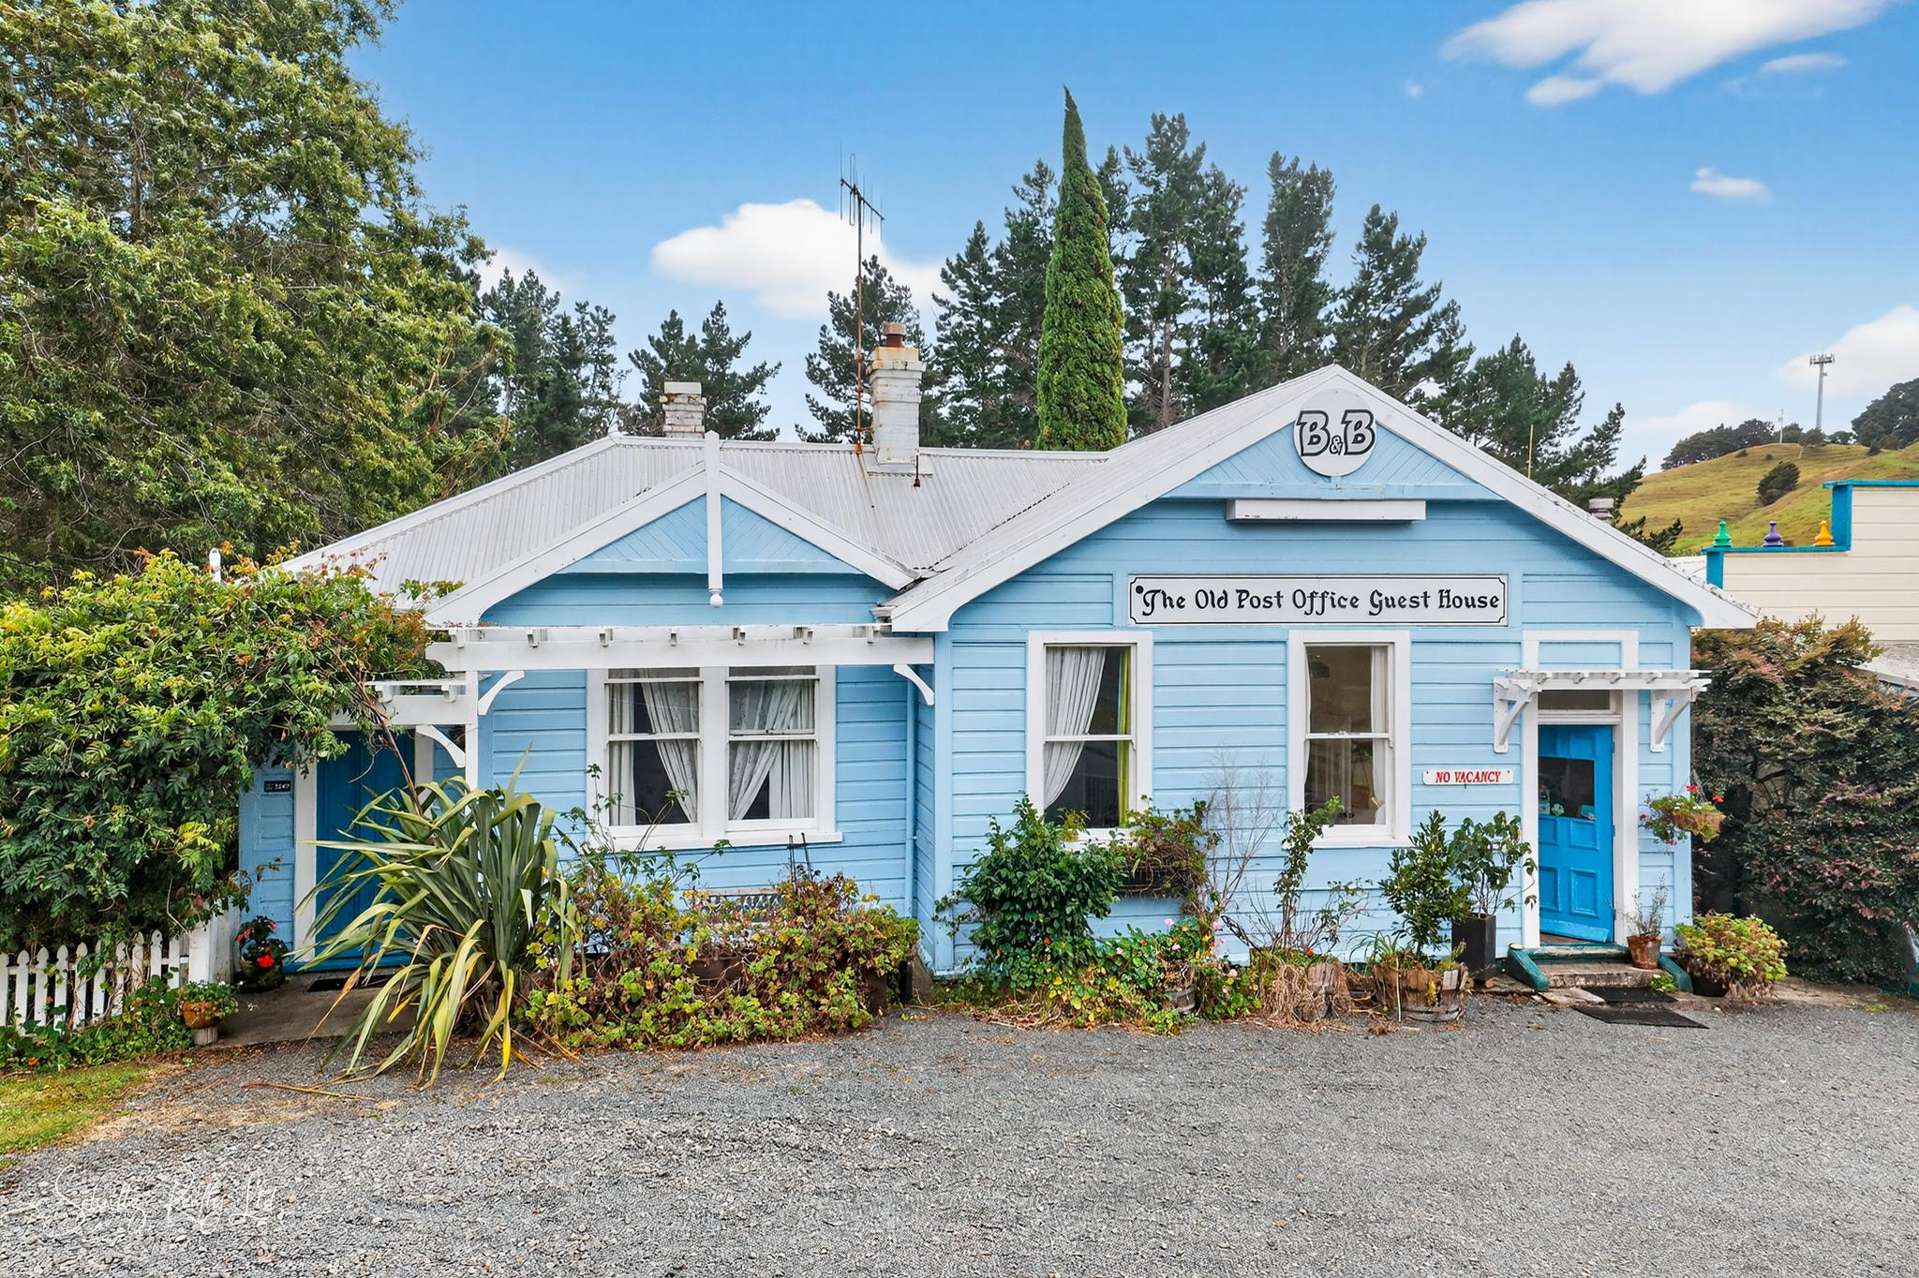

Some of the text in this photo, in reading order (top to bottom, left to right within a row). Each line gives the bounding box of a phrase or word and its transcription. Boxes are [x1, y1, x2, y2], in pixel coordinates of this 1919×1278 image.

[1296, 409, 1376, 457] B&B
[1141, 588, 1501, 617] The Old Post Office Guest House
[1435, 770, 1502, 783] NO VACANCY
